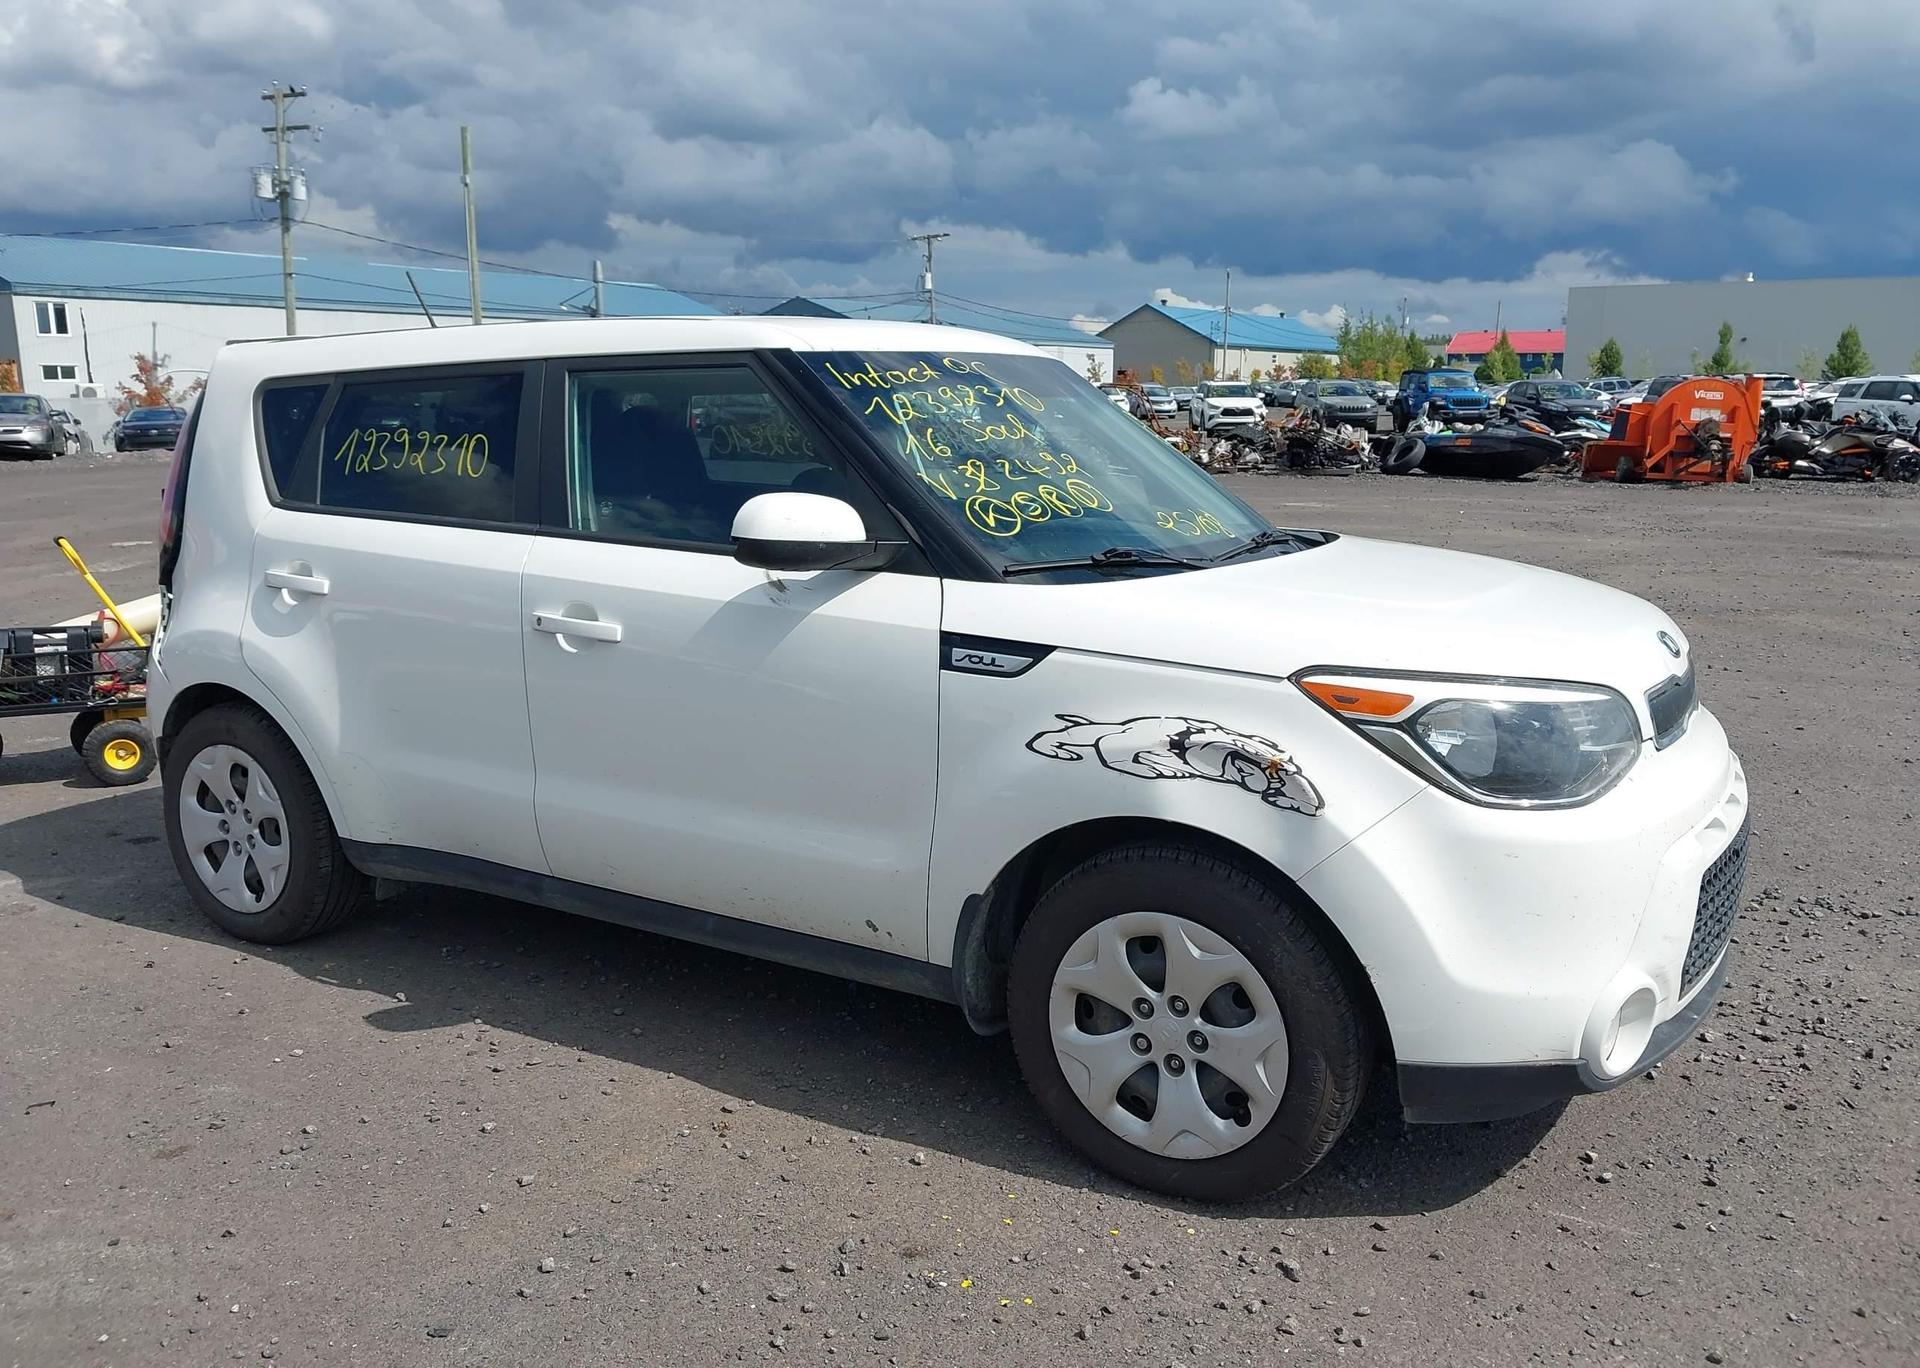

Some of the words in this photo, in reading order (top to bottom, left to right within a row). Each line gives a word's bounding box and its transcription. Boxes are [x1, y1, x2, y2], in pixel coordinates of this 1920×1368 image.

[825, 361, 942, 390] Intact
[865, 384, 1045, 425] 12392310
[334, 427, 490, 478] 12392310
[905, 428, 953, 461] 16
[963, 414, 1049, 445] Soul
